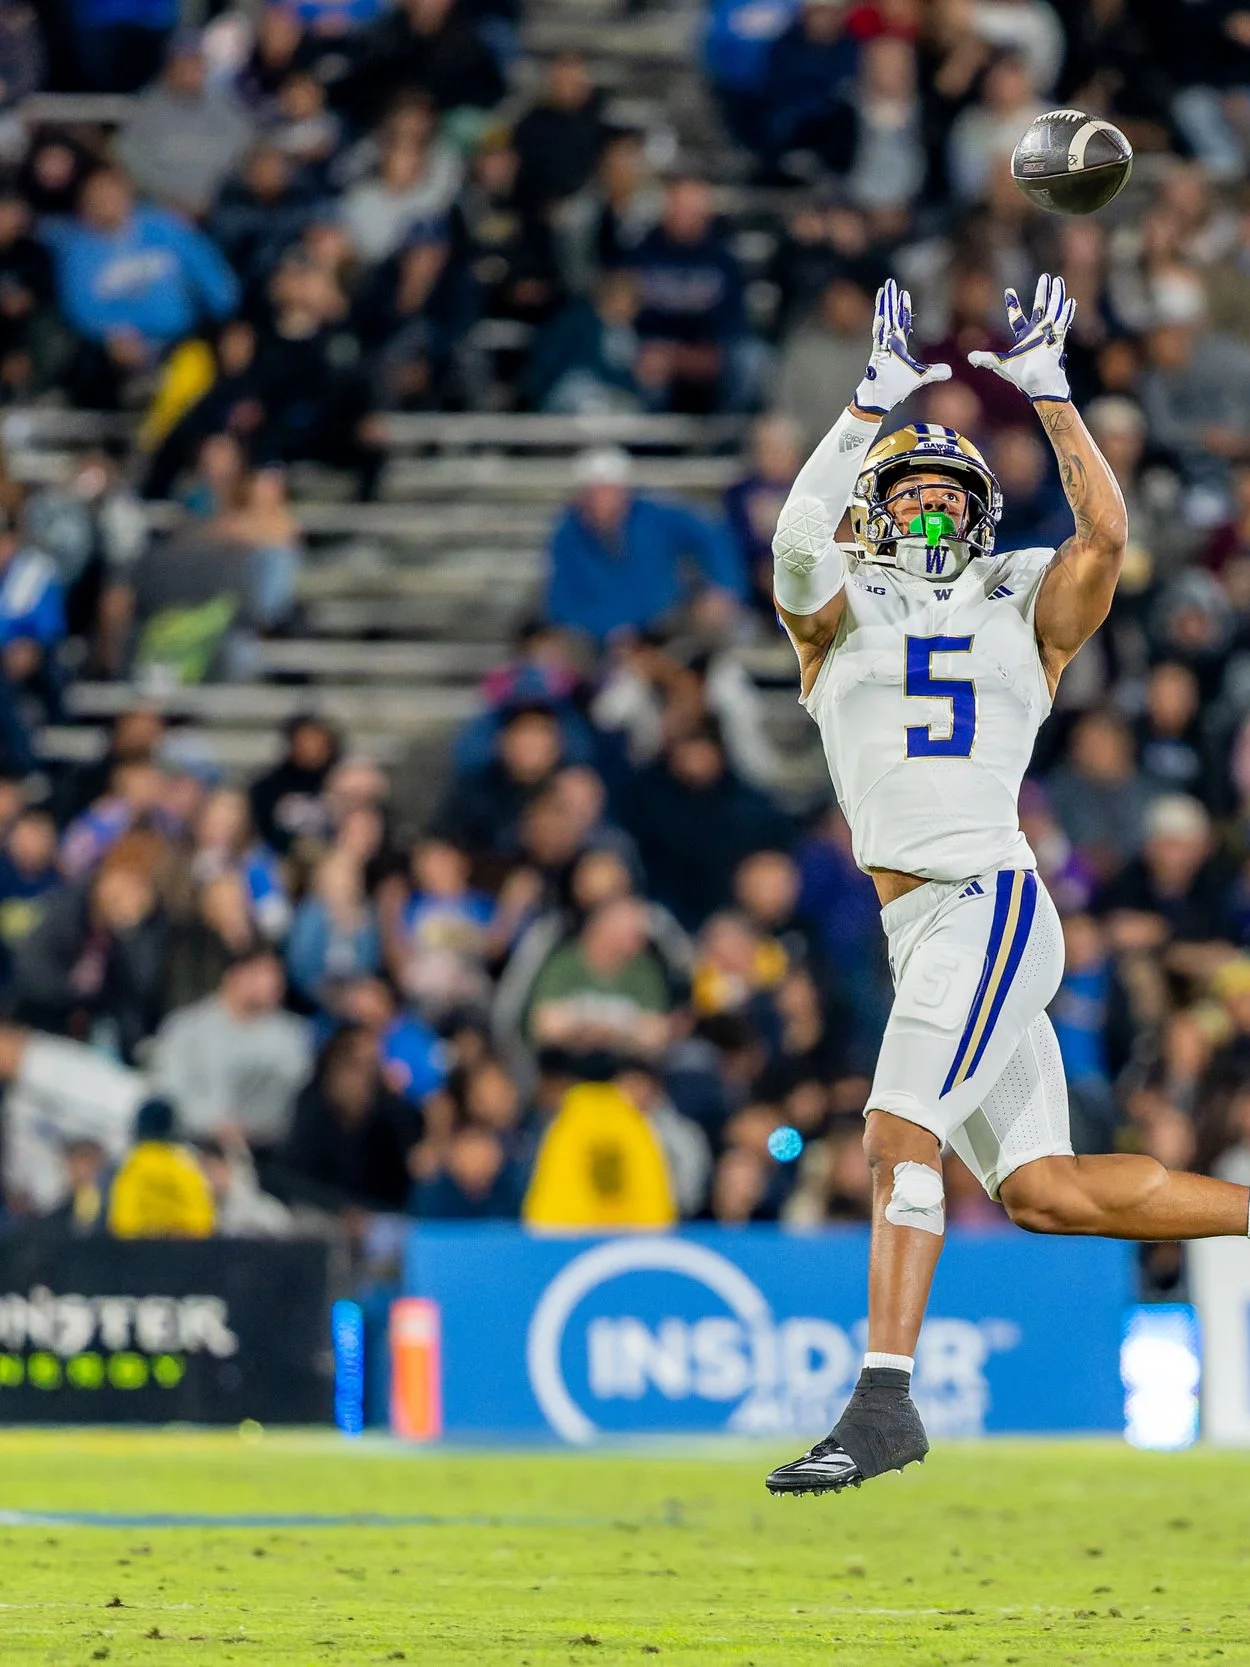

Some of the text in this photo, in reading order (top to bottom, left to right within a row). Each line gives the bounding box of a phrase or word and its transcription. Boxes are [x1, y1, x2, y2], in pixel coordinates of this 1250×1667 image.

[925, 545, 949, 574] W
[933, 588, 954, 602] W
[903, 633, 979, 760] 5
[587, 1315, 988, 1401] INSIDR
